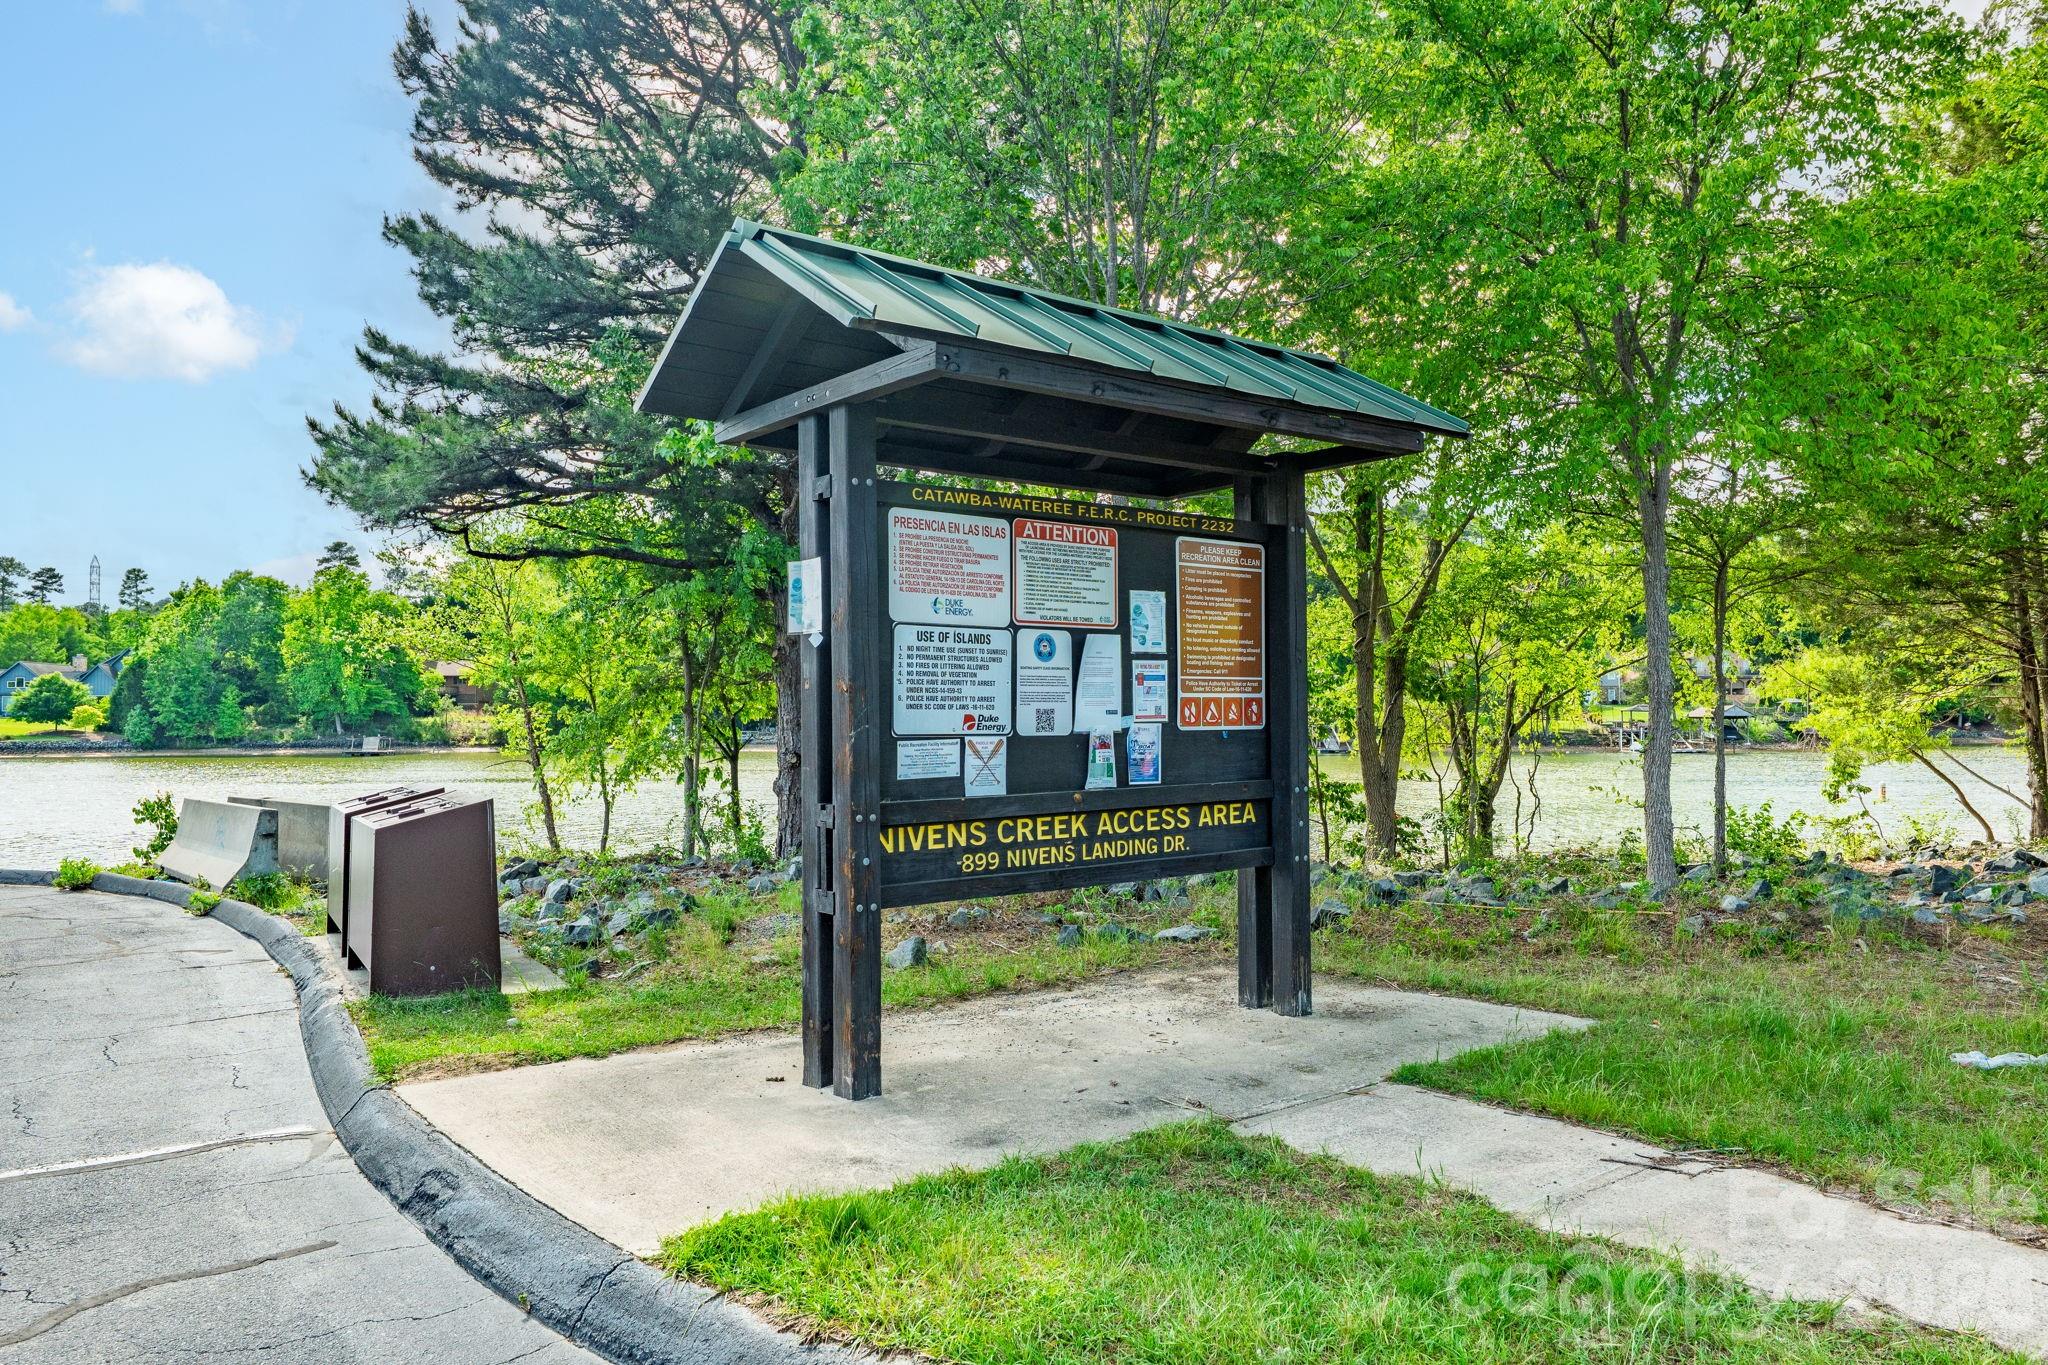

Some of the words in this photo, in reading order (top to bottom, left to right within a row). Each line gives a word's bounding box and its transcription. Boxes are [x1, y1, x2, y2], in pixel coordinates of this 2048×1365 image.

[912, 487, 1073, 516] CATAWBA-WATEREE
[1078, 504, 1132, 522] F.E.R.C.
[1137, 511, 1198, 530] PROJECT
[1201, 518, 1234, 533] 2232
[894, 516, 946, 532] PRESENCIA
[948, 522, 959, 534] EN
[963, 523, 979, 536] LAS
[982, 525, 1006, 538] ISLAS
[1023, 522, 1109, 545] ATTENTION
[1182, 553, 1220, 562] RECREATION
[1201, 546, 1224, 554] PLEASE
[945, 599, 963, 607] DUKE
[917, 631, 934, 642] USE
[938, 632, 950, 643] OF
[954, 633, 991, 644] ISLANDS
[977, 723, 1006, 731] Energy
[880, 822, 988, 854] NIVENS
[997, 815, 1088, 844] CREEK
[1098, 807, 1191, 836] ACCESS
[1198, 802, 1256, 828] AREA
[1008, 844, 1076, 868] NIVENS
[1082, 838, 1158, 860] LANDING
[1164, 835, 1190, 852] DR.
